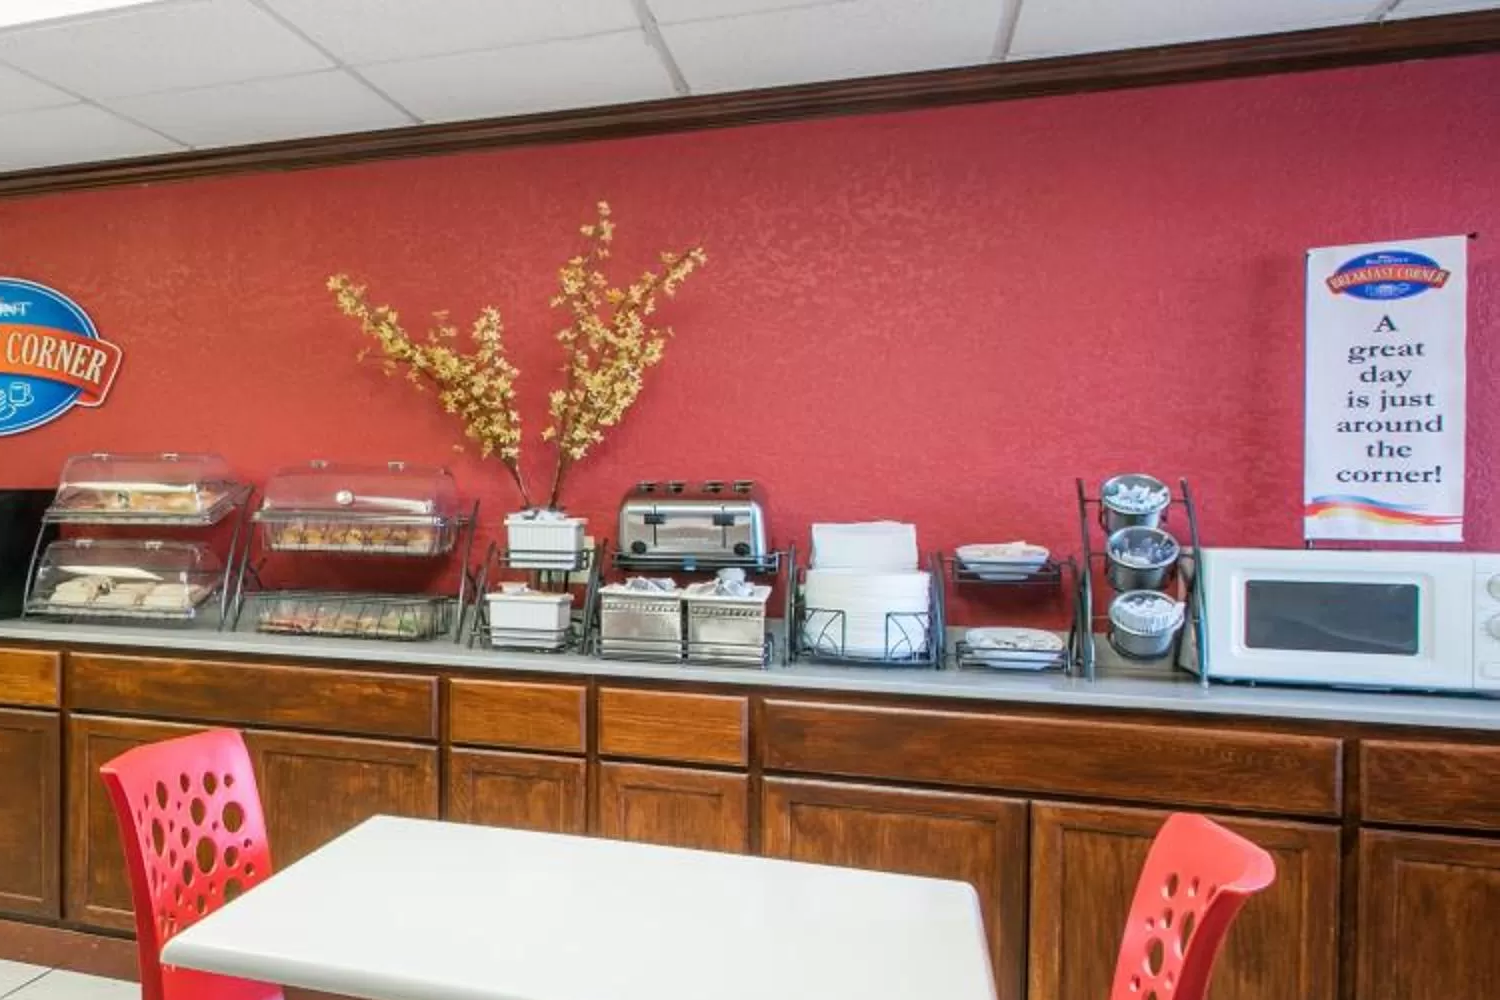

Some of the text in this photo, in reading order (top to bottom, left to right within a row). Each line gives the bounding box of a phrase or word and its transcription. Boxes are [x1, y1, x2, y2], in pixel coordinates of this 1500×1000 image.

[1396, 267, 1445, 283] CORNER
[1373, 314, 1397, 332] A
[7, 331, 108, 385] CORNER
[1347, 343, 1425, 364] great
[1359, 365, 1412, 388] day
[1347, 391, 1436, 413] is just
[1336, 414, 1444, 433] around
[1366, 441, 1413, 458] the
[1336, 465, 1443, 483] corner!
